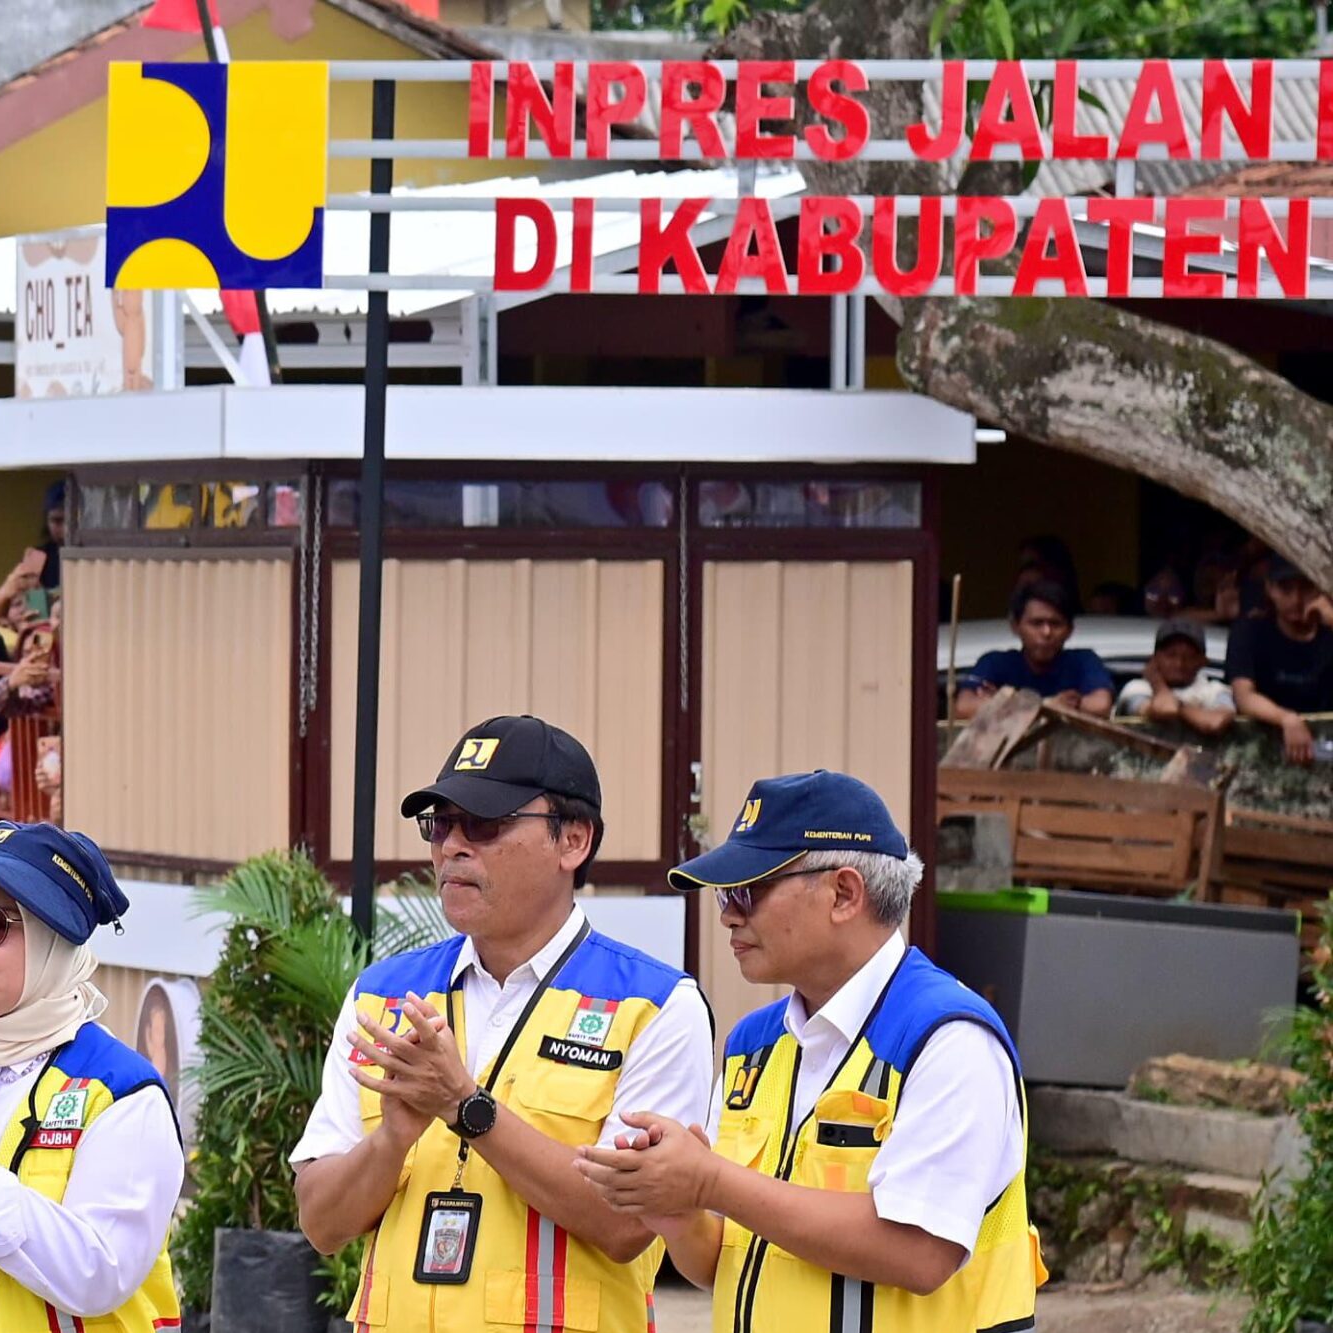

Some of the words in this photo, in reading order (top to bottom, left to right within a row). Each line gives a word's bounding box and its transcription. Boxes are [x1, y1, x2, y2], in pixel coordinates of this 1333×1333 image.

[469, 59, 870, 161] INPRES
[905, 59, 1275, 161] JALAN
[494, 196, 595, 294] DI
[637, 195, 1311, 299] KABUPATEN
[804, 830, 852, 840] KEMENTERIAN
[854, 833, 872, 842] PUPR
[549, 1041, 611, 1066] NYOMAN
[39, 1132, 73, 1145] DJBM
